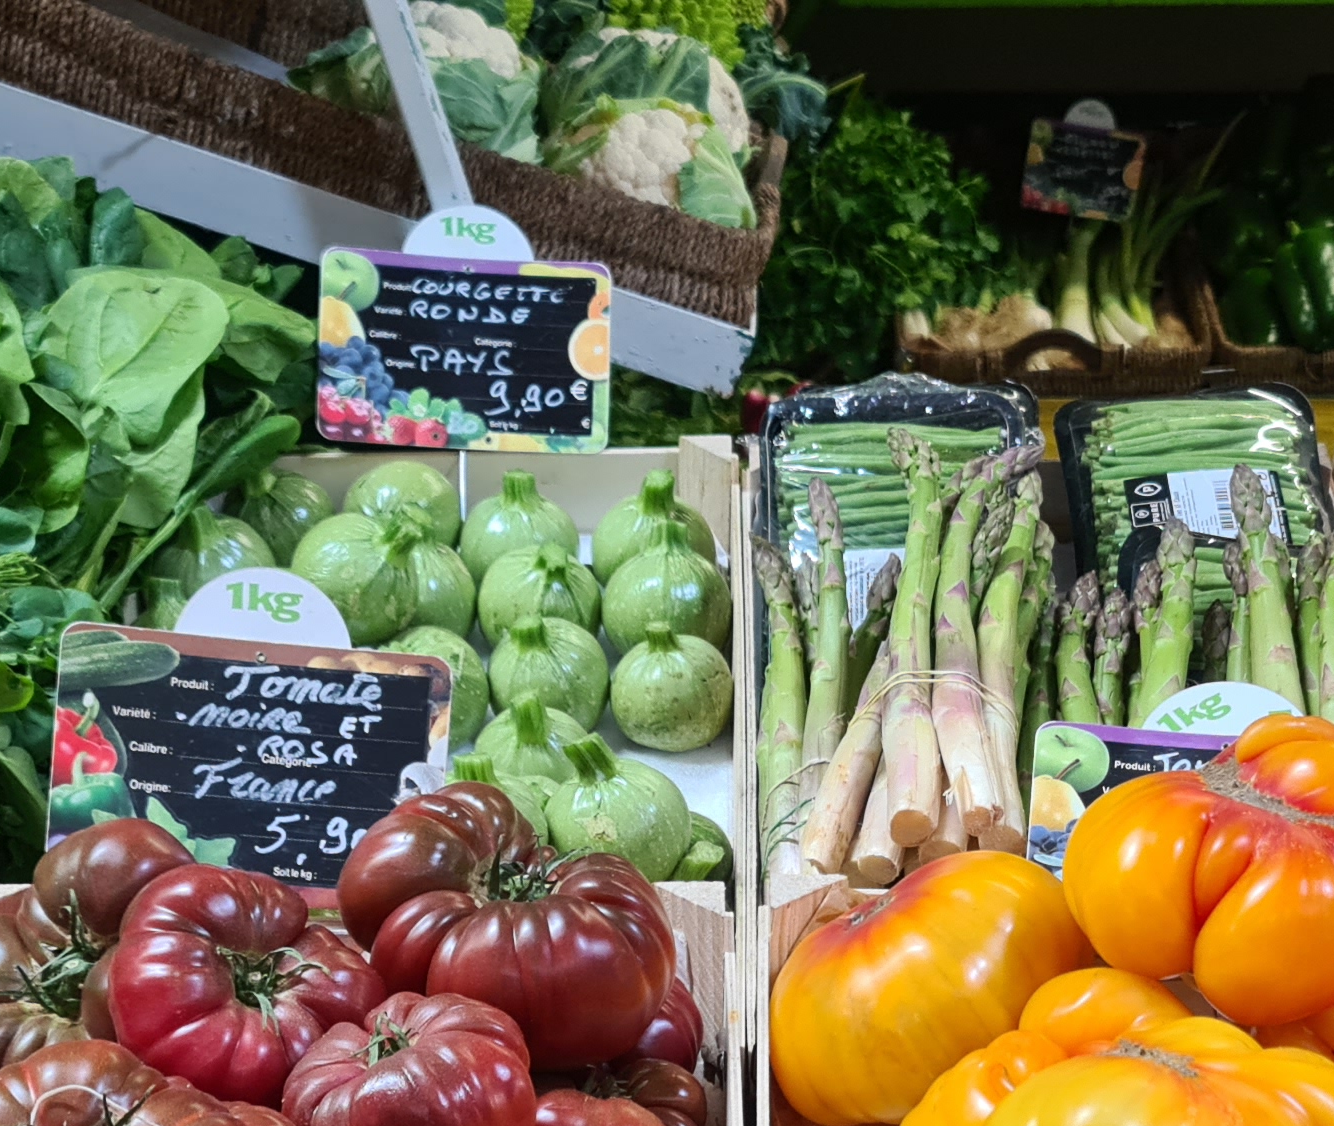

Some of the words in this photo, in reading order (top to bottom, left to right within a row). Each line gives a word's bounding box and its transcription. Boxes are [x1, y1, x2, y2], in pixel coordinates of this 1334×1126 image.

[440, 217, 496, 244] 1kg
[411, 279, 566, 303] COURGETTE
[409, 301, 530, 323] RONDE
[410, 346, 514, 376] PAYS
[571, 380, 588, 401] €
[226, 582, 305, 623] 1kg
[224, 665, 383, 711] Tomate
[1157, 693, 1232, 733] 1kg
[339, 716, 383, 739] ET
[257, 736, 357, 766] ROSA
